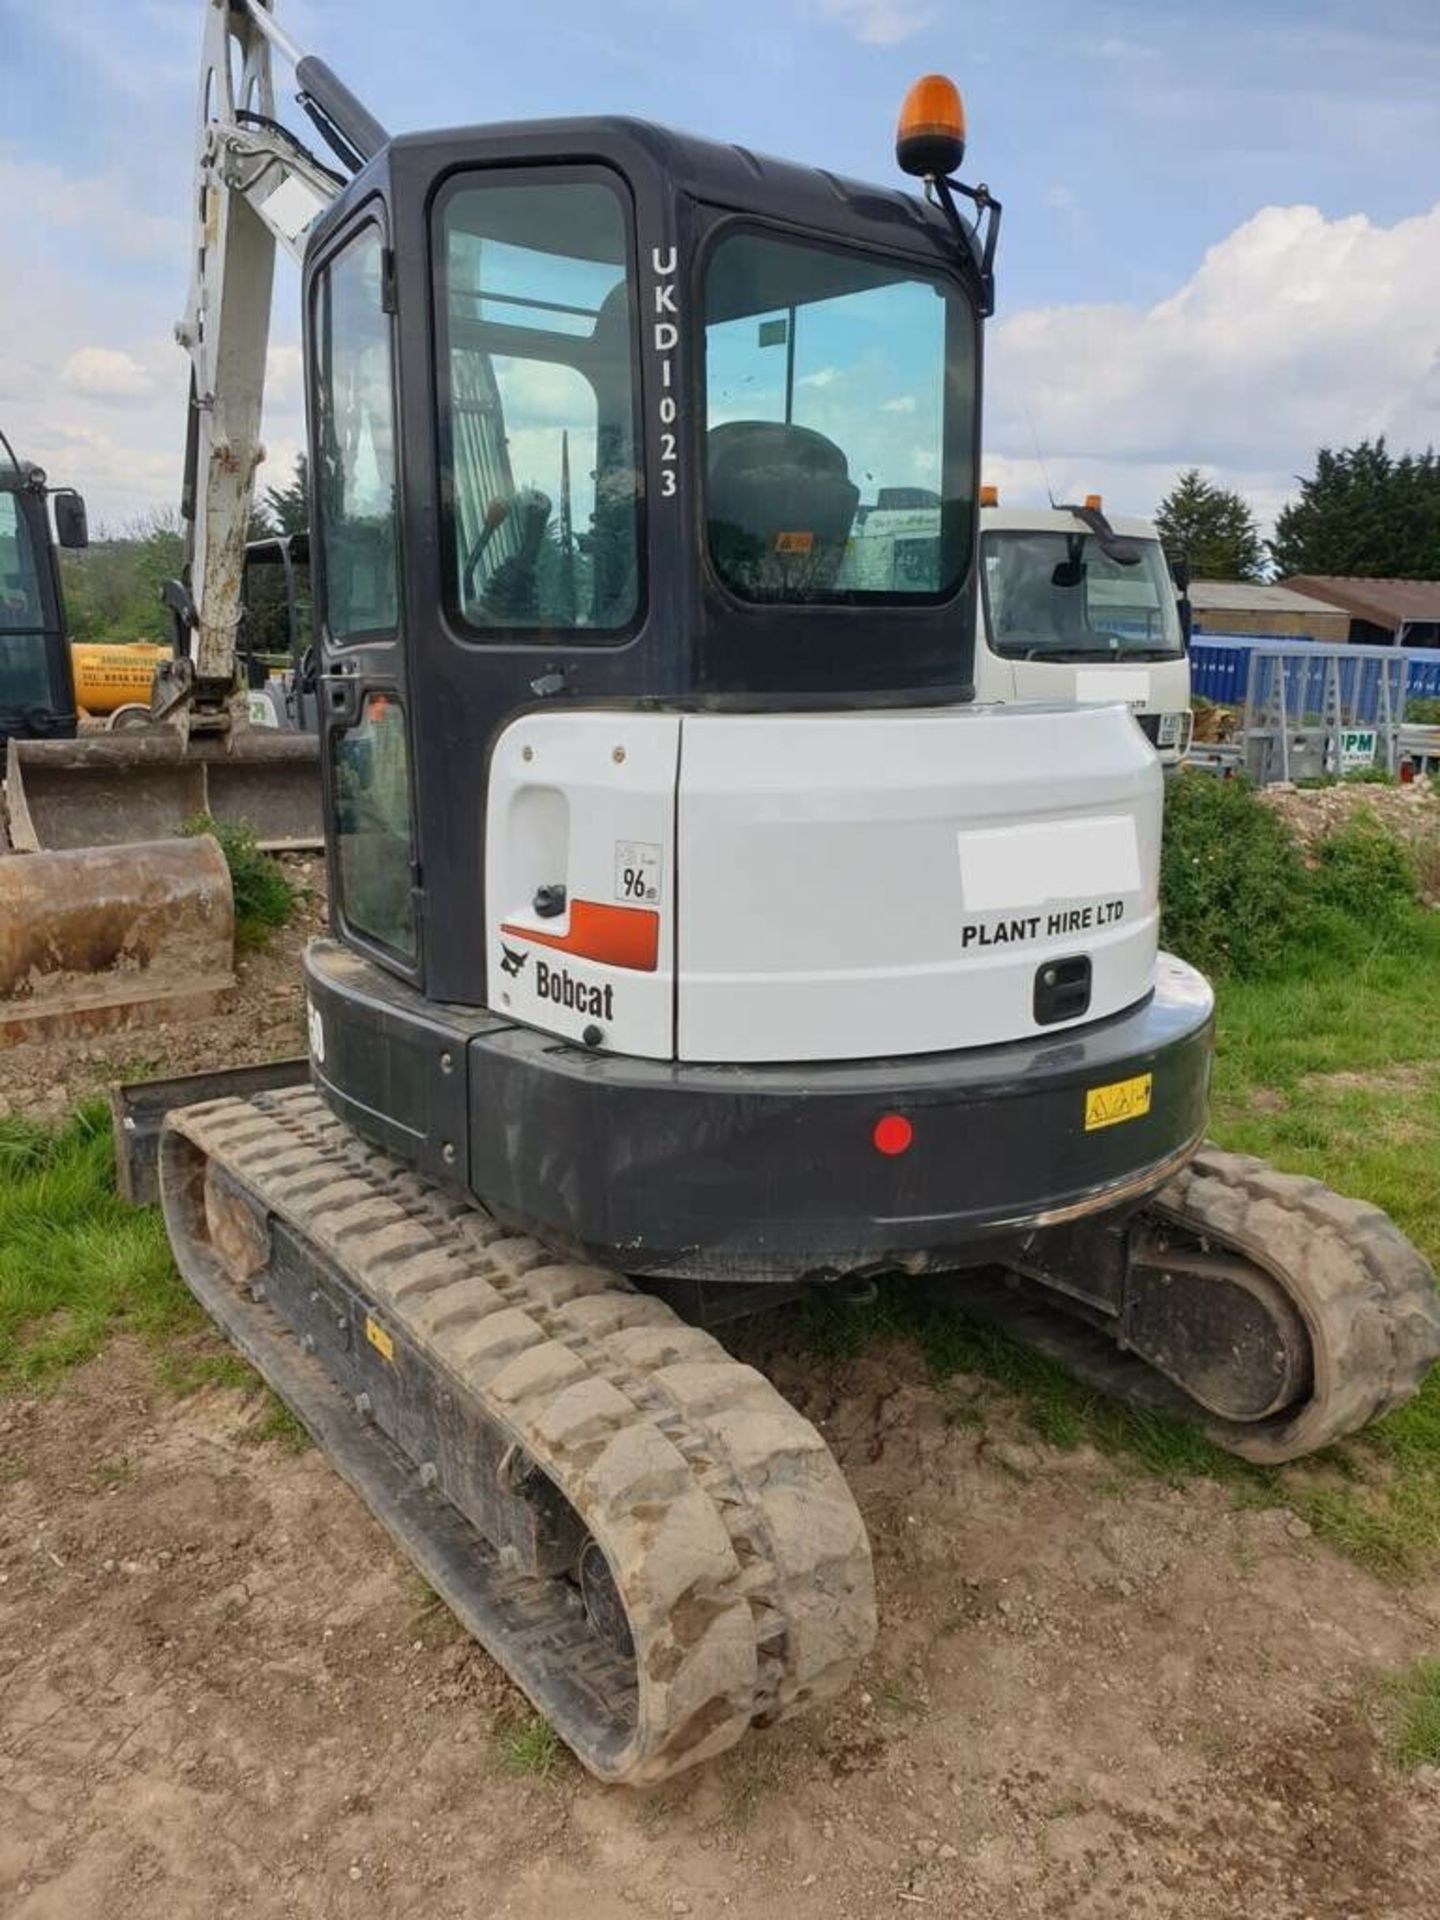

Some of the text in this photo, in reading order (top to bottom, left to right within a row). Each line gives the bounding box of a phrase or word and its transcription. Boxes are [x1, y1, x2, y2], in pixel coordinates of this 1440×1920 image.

[624, 868, 645, 898] 96
[961, 900, 1124, 948] PLANT HIRE LTD
[536, 960, 614, 1021] Bobcat
